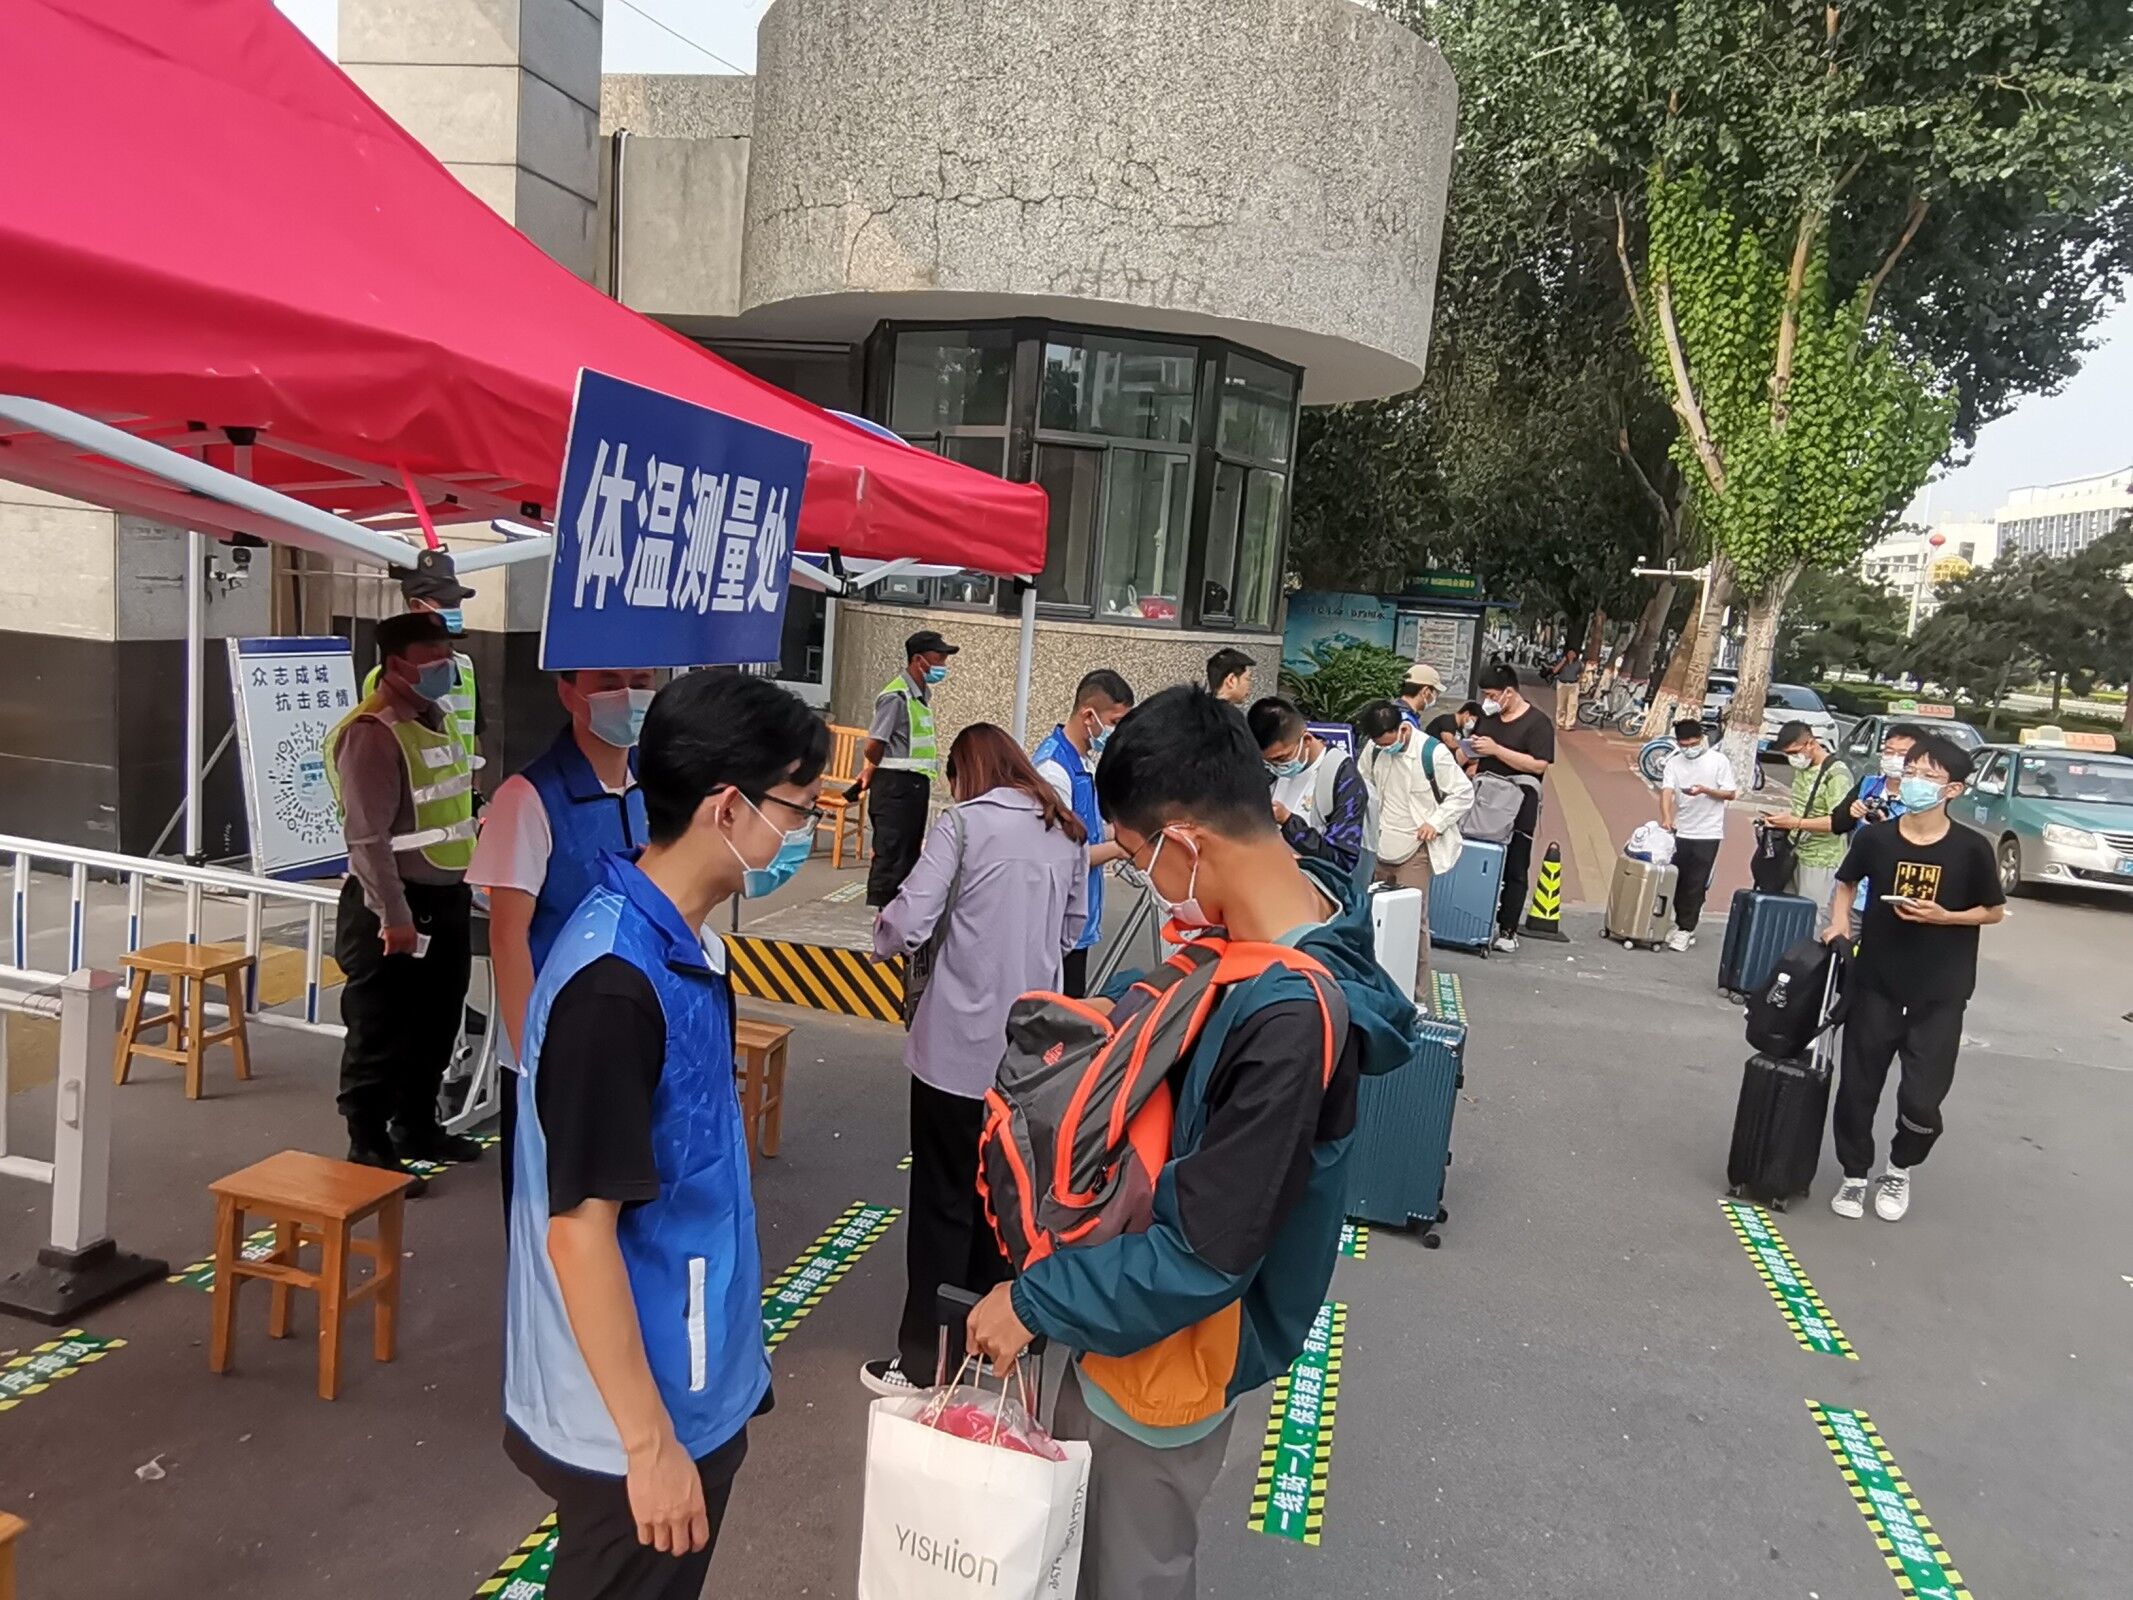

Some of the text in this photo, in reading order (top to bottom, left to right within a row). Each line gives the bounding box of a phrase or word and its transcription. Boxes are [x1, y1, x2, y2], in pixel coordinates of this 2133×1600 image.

[573, 438, 789, 615] 体温测量处
[251, 664, 329, 687] 众志成城
[274, 689, 350, 712] 抗击疫情
[1901, 864, 1937, 883] 中国
